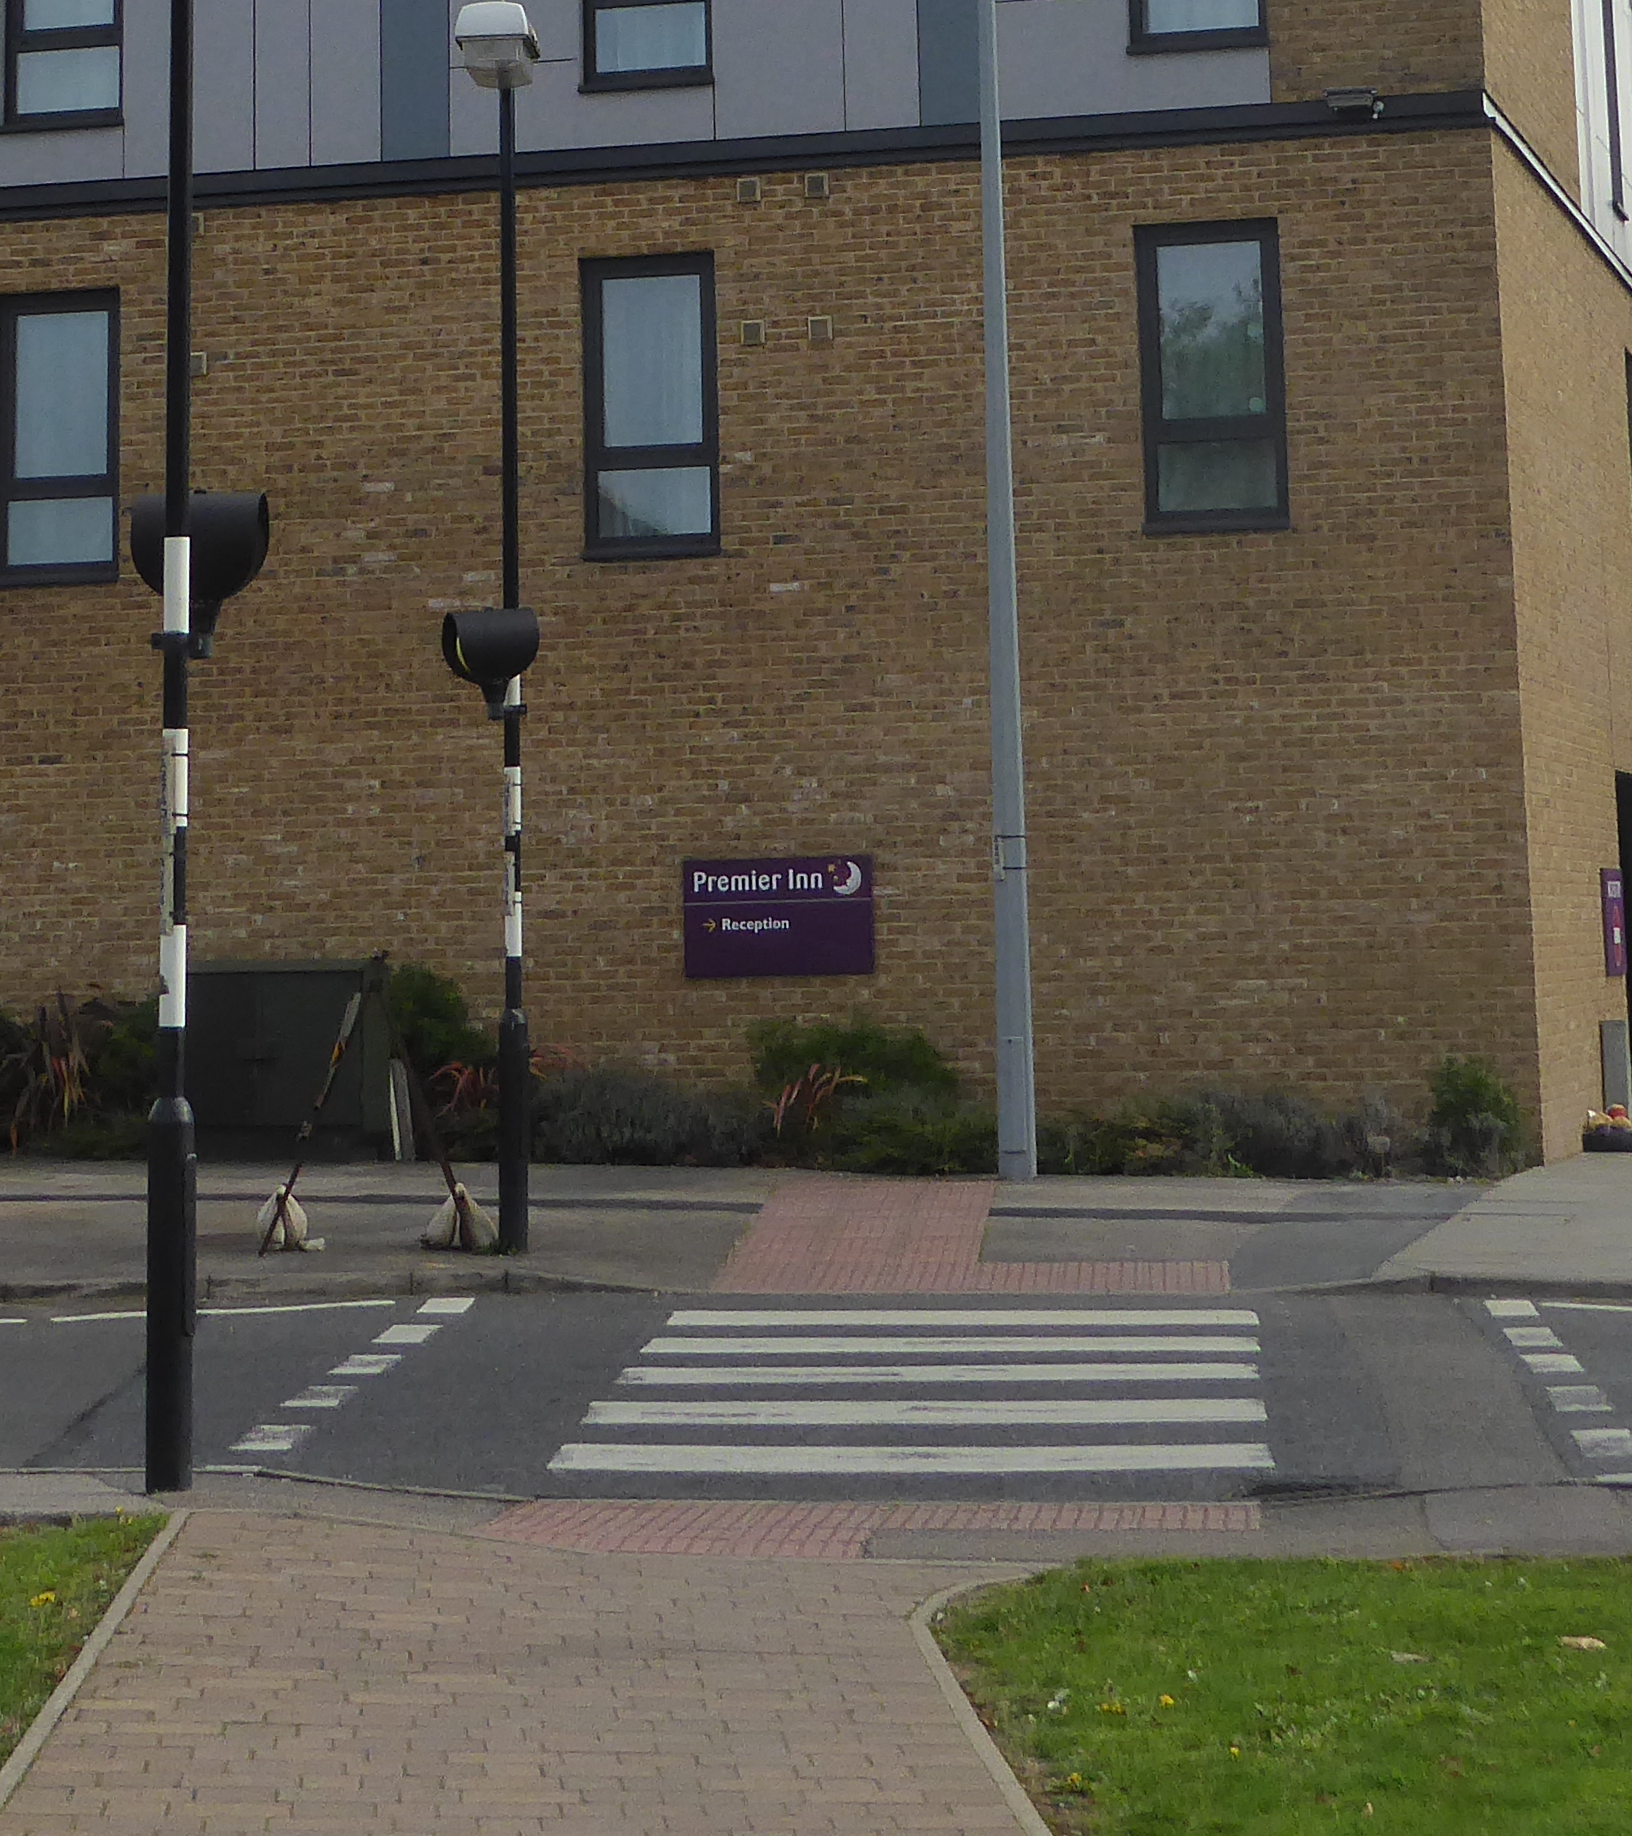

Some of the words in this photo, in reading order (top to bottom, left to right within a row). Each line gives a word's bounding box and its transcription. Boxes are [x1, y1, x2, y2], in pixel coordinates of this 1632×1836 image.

[693, 870, 782, 893] Premier
[788, 869, 823, 890] Inn
[721, 916, 790, 933] Reception
